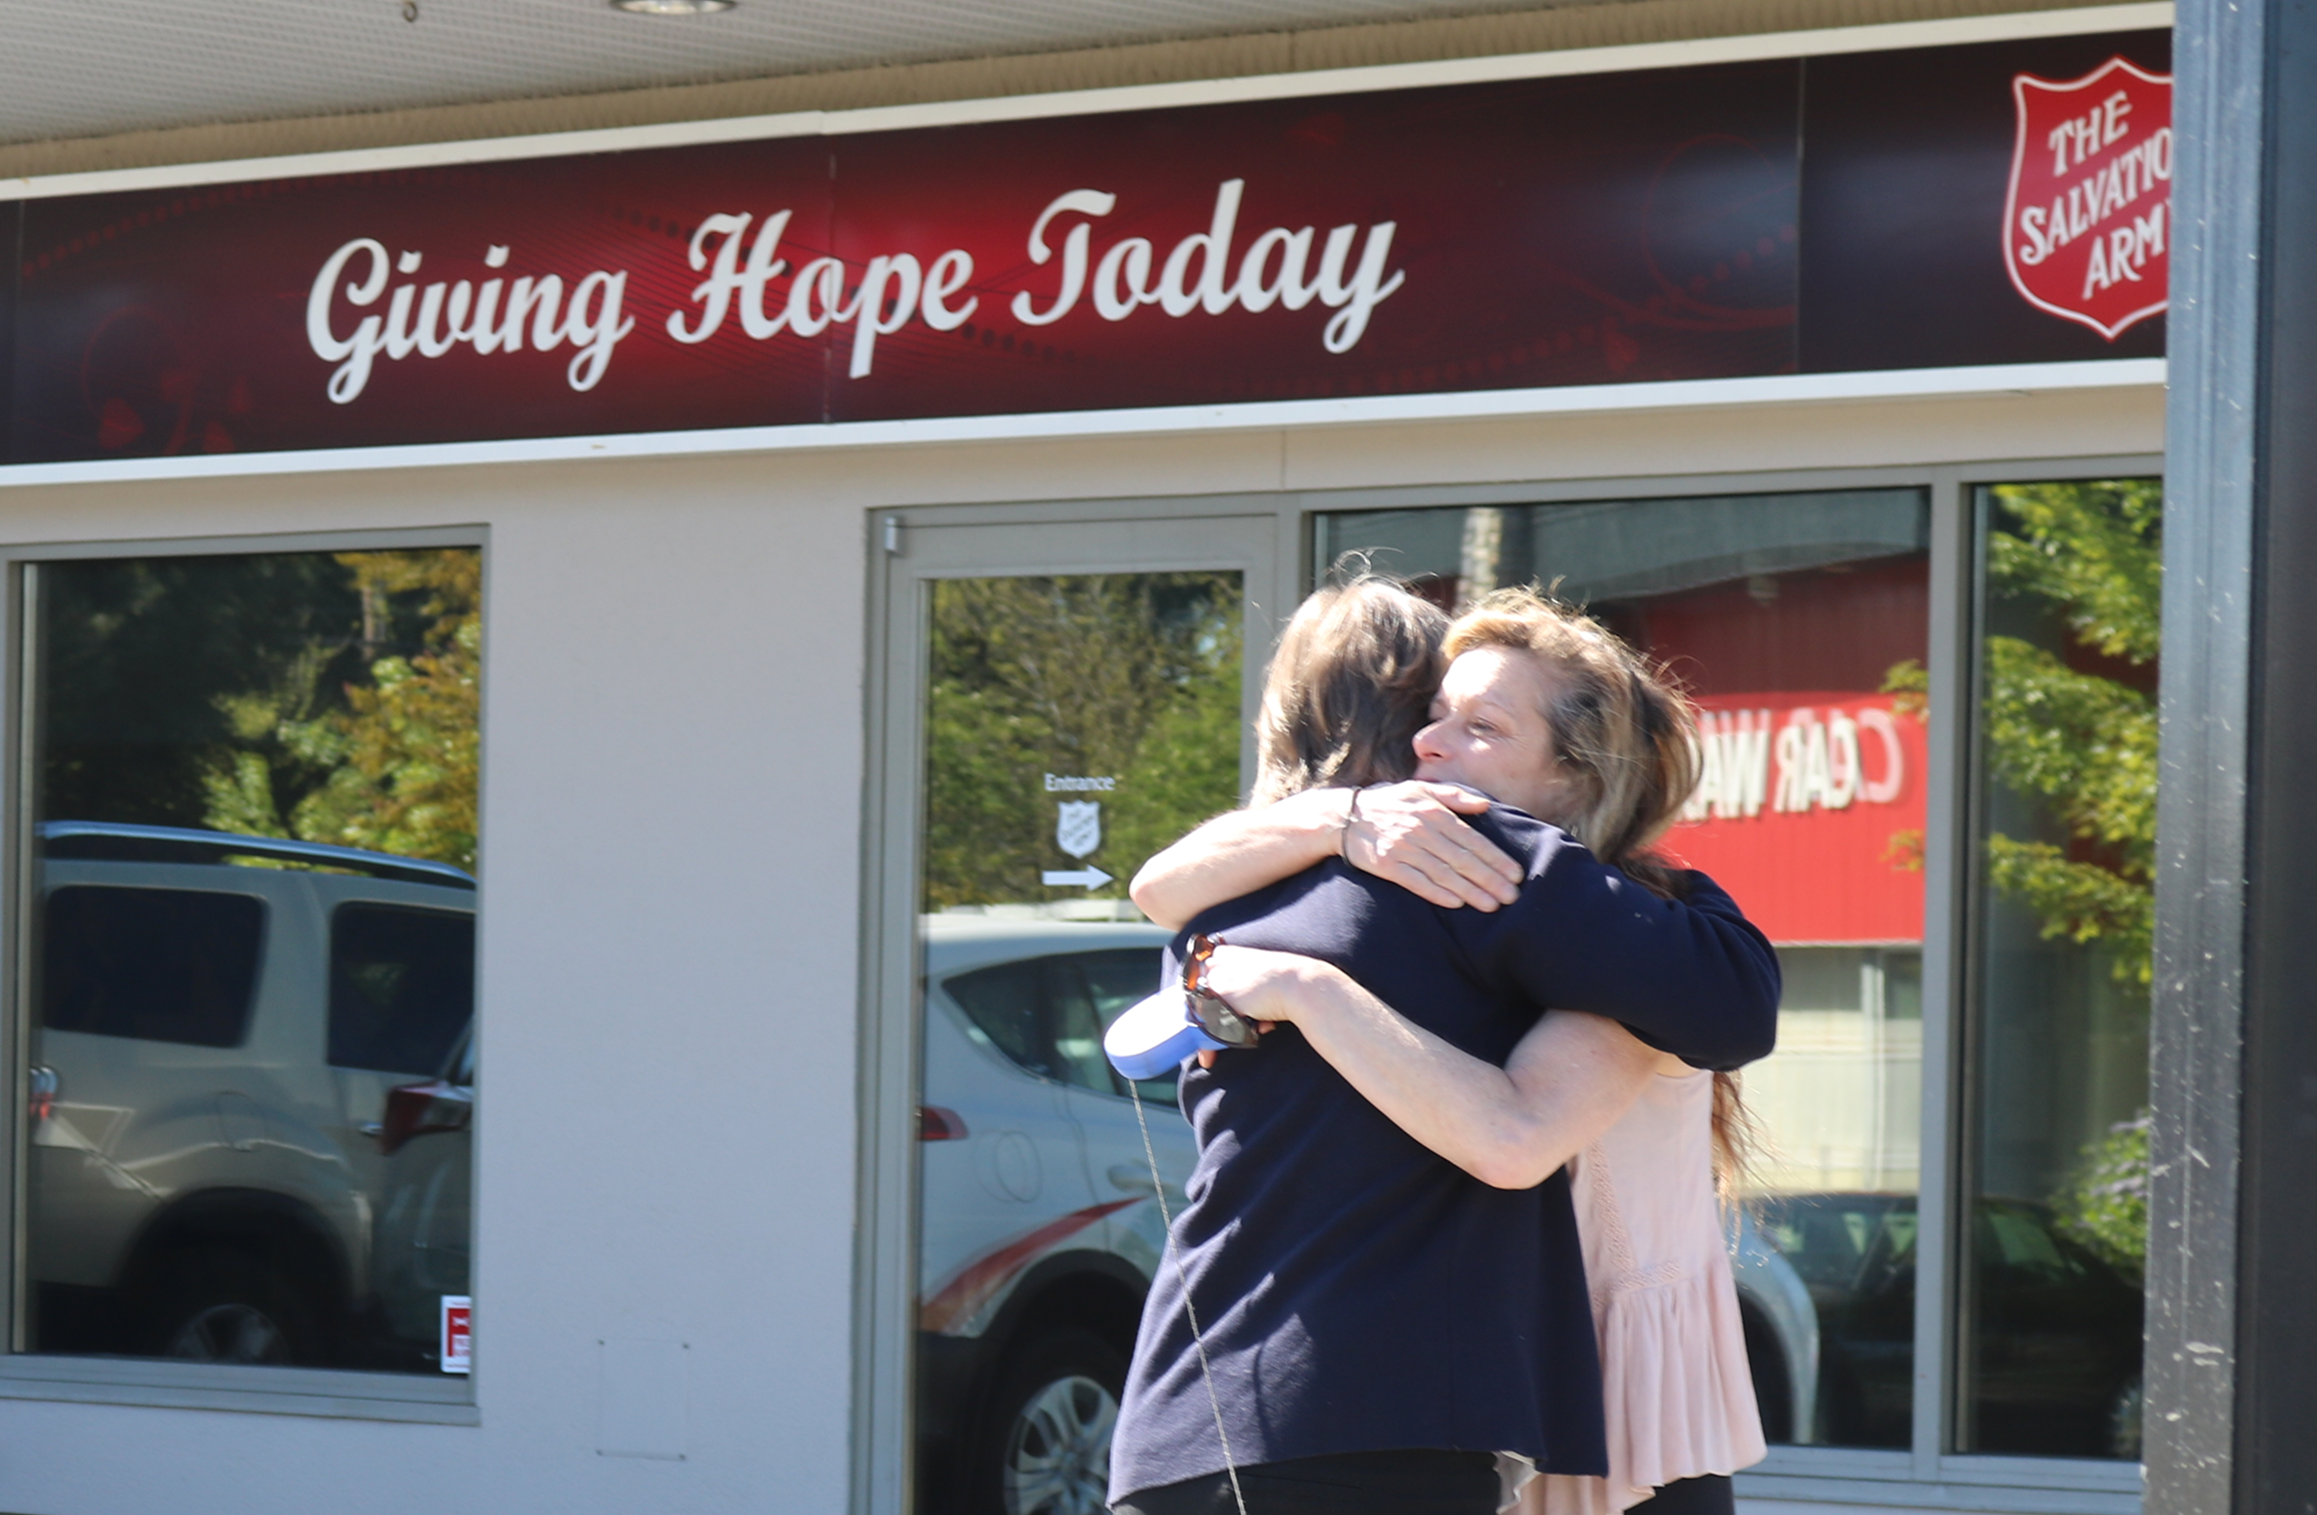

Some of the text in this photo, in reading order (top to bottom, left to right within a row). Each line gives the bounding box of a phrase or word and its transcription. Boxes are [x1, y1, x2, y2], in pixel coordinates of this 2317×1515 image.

[2048, 89, 2132, 178] THE
[2019, 126, 2172, 266] SALVATIO
[306, 177, 1405, 404] Giving Hope Today
[2081, 197, 2171, 301] ARM
[1044, 772, 1116, 792] Entrance
